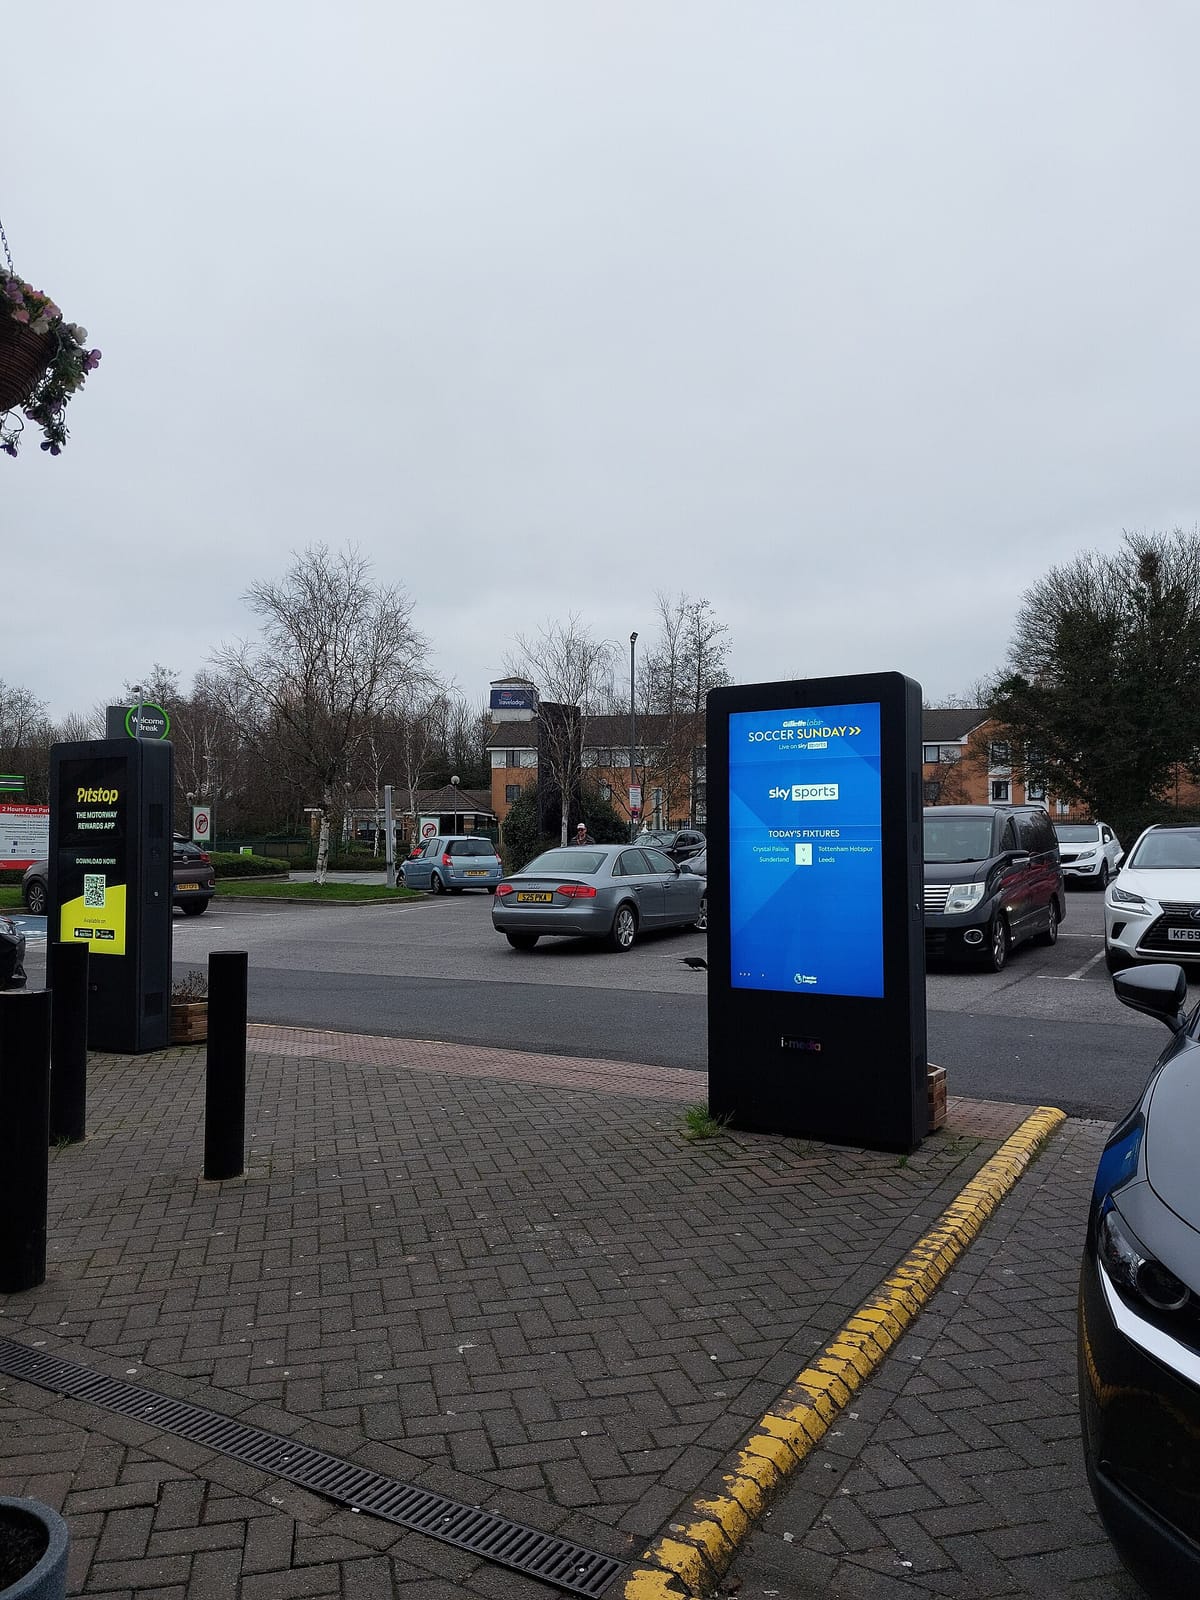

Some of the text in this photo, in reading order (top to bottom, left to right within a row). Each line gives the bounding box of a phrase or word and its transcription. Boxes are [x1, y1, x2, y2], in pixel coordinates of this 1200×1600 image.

[748, 726, 847, 742] SOCCER SUNDAY
[77, 787, 119, 805] Pitstop
[768, 786, 836, 801] sky sports
[76, 811, 118, 819] THE MOTORWAY
[77, 822, 103, 830] REWARDS
[768, 829, 840, 838] TODAY'S FIXTURES
[1173, 929, 1200, 940] KF69
